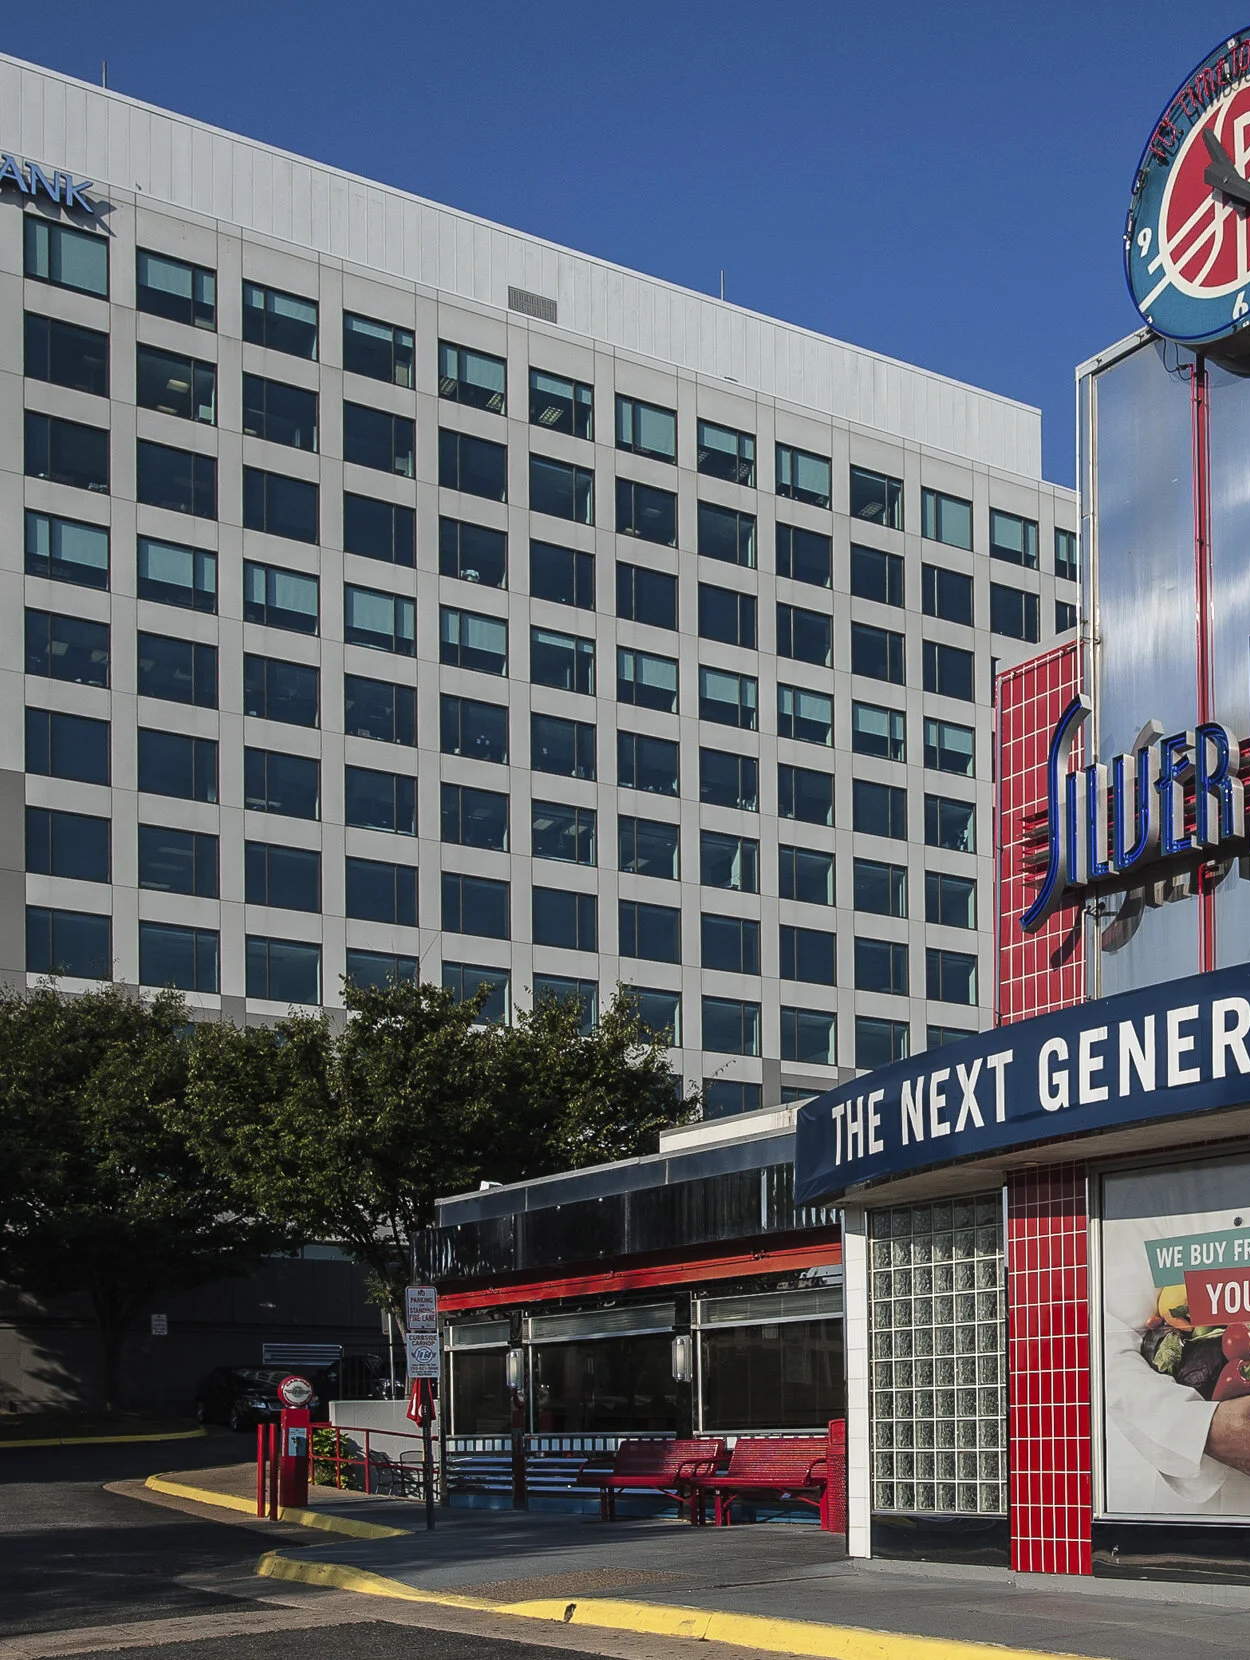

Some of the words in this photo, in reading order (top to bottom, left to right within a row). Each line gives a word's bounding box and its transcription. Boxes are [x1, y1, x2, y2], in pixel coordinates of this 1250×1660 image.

[1137, 227, 1152, 258] 9
[1233, 291, 1249, 319] 6
[1020, 694, 1245, 933] SILVER
[831, 1088, 885, 1165] THE
[901, 1049, 1013, 1145] NEXT
[1156, 1246, 1184, 1269] WE
[1190, 1241, 1226, 1266] BUY
[417, 1289, 426, 1297] NO
